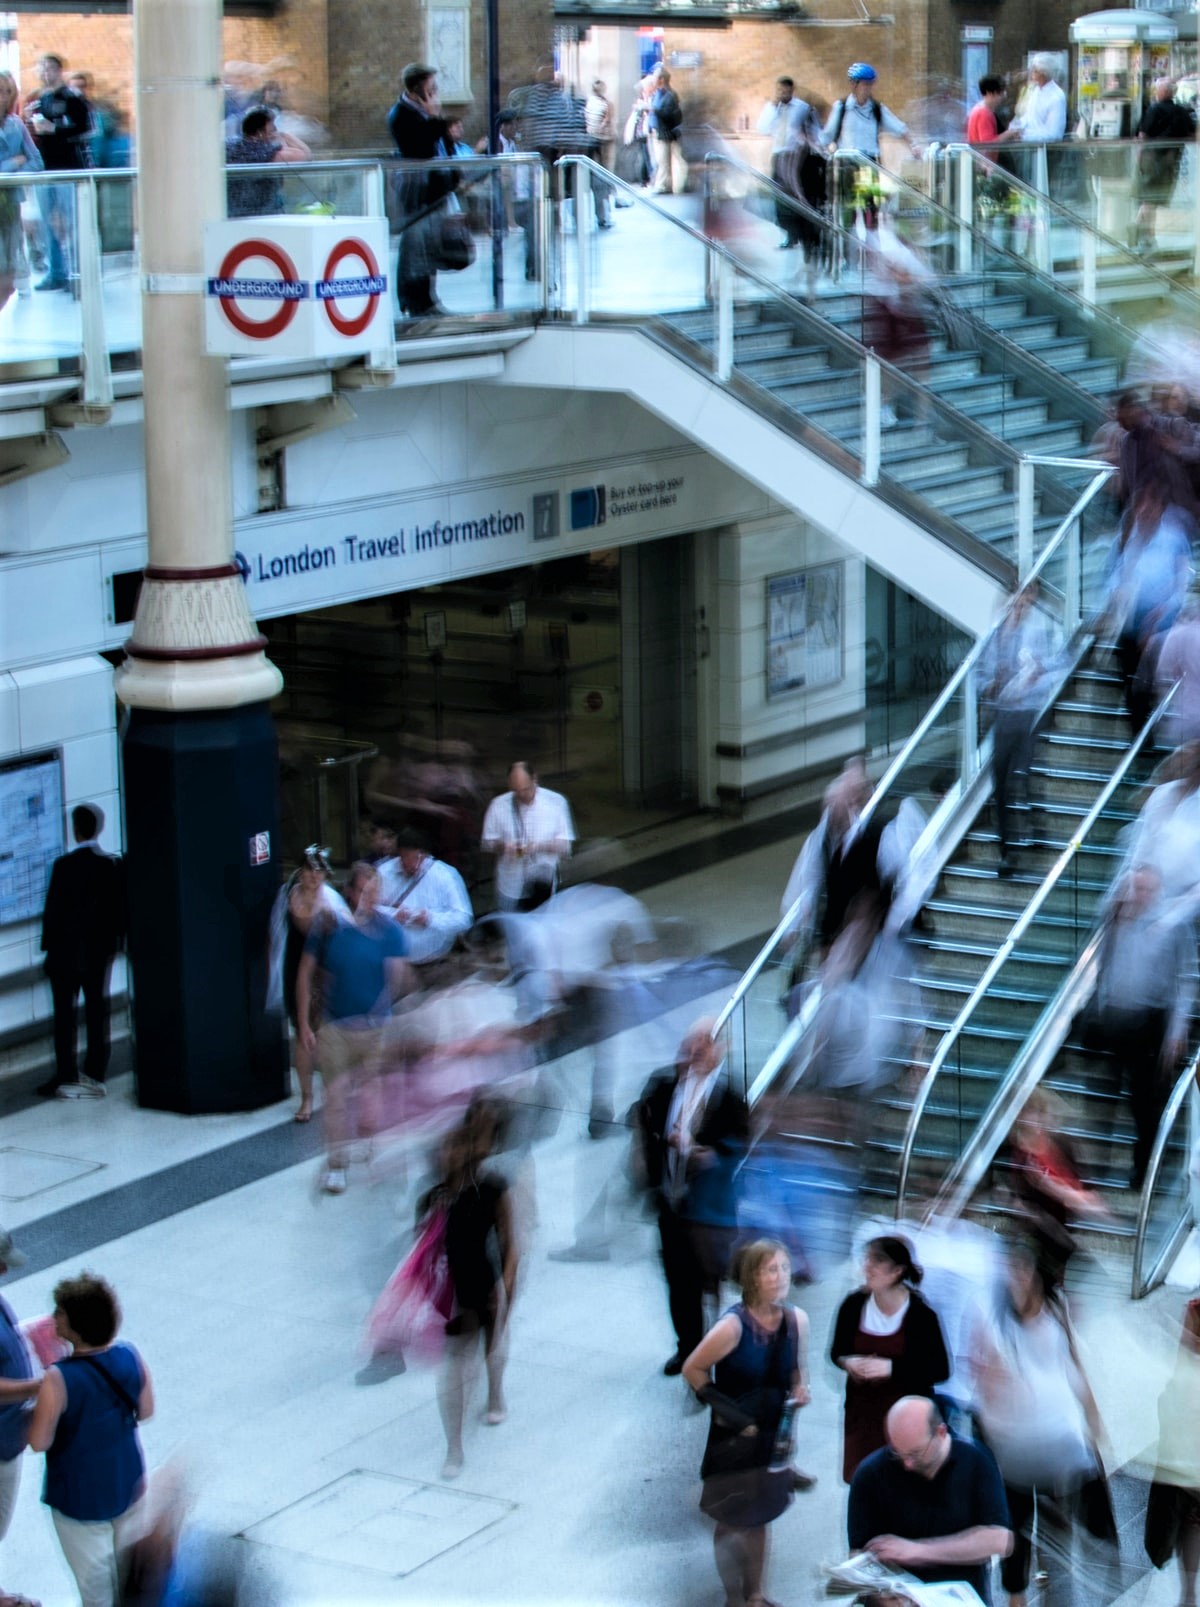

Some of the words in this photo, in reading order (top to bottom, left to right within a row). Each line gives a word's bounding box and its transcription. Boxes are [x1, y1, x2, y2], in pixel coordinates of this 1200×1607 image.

[213, 280, 304, 296] UNDERGROUND
[319, 278, 384, 295] UNDERGROUND
[257, 543, 336, 582] London
[345, 526, 406, 562] Travel
[415, 510, 525, 551] Information
